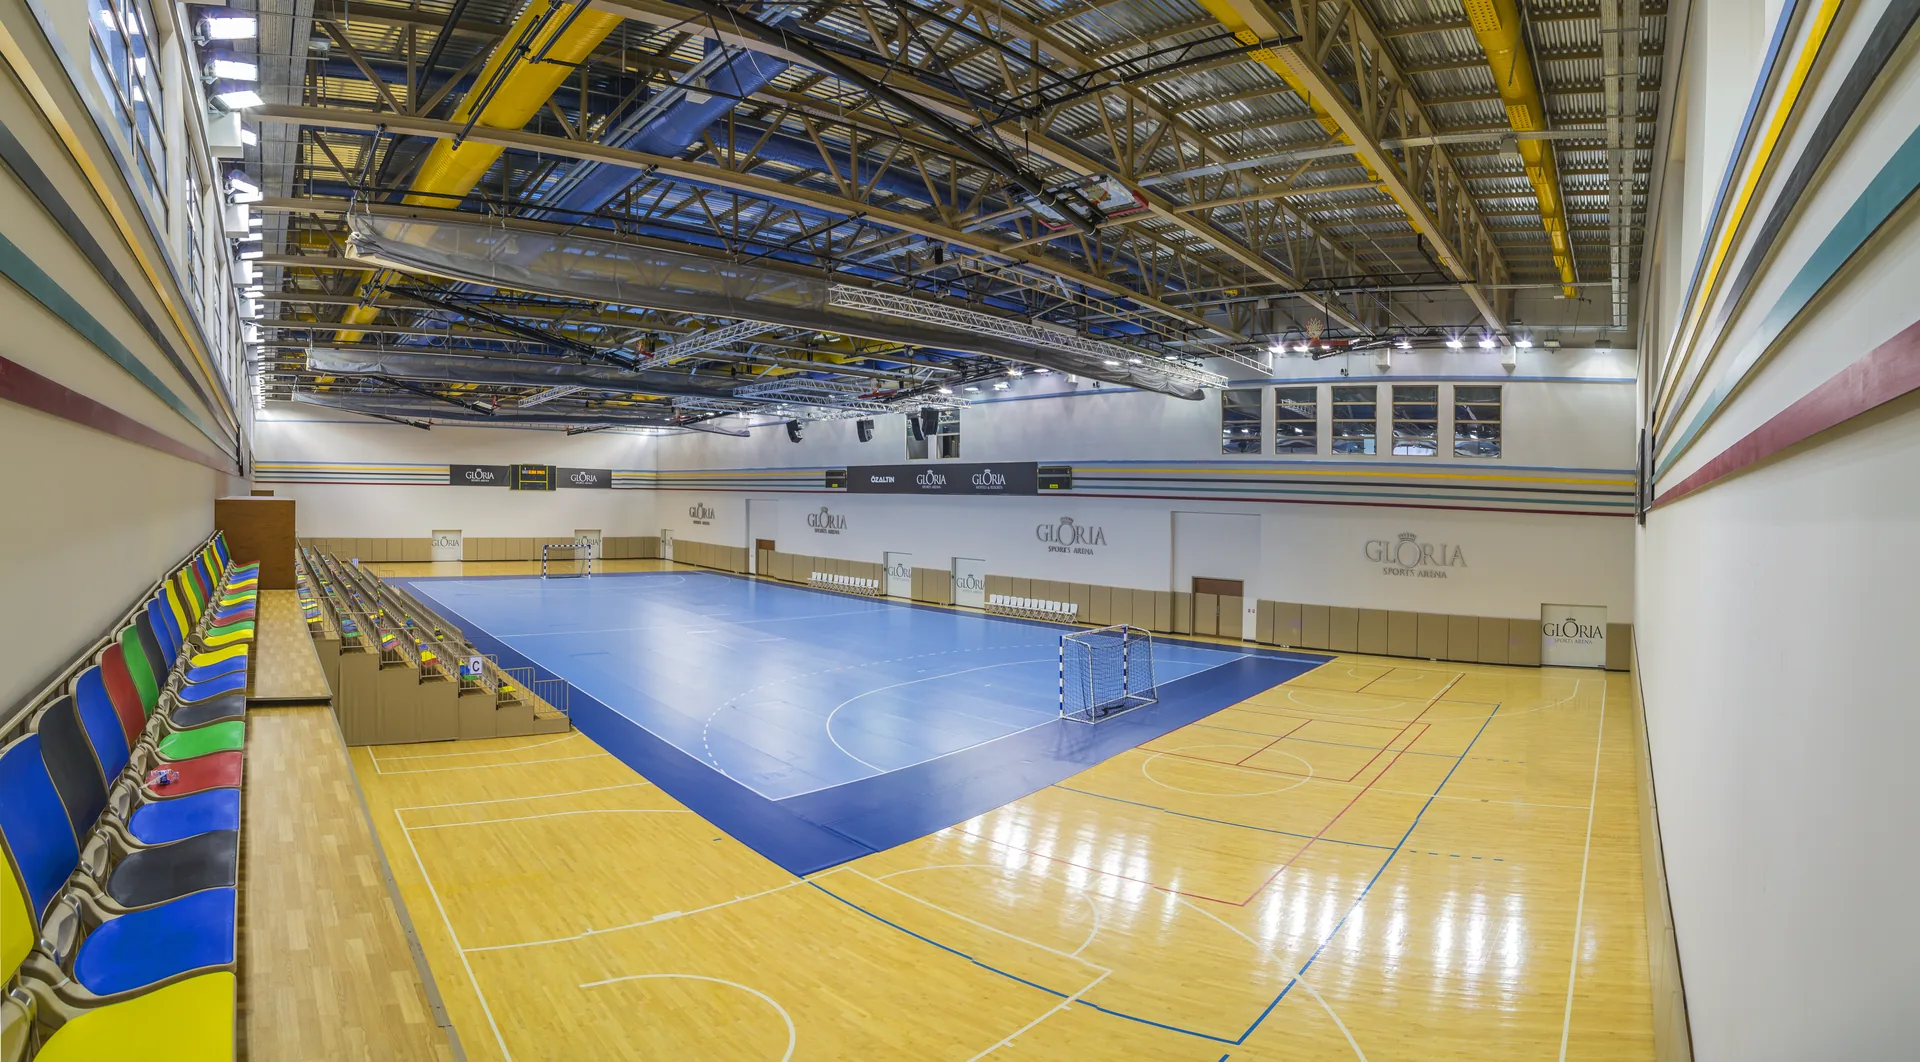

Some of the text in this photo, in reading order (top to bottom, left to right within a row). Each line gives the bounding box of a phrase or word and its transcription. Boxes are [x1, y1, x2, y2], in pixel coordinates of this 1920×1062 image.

[465, 469, 495, 480] GLORIA
[570, 472, 598, 482] GLORIA
[916, 472, 947, 485] GLORIA
[971, 472, 1006, 485] GLORIA
[689, 505, 716, 520] GLORIA
[807, 512, 848, 530] GLORIA
[1036, 523, 1108, 547] GLORIA
[431, 538, 460, 548] GLORIA
[1048, 545, 1094, 555] SPORTS ARENA
[1365, 540, 1468, 569] GLORIA
[888, 565, 911, 579] GLORI
[1383, 567, 1447, 579] SPORTS ARENA
[956, 576, 985, 590] GLORI
[1542, 621, 1604, 639] GLORIA
[472, 660, 480, 672] C
